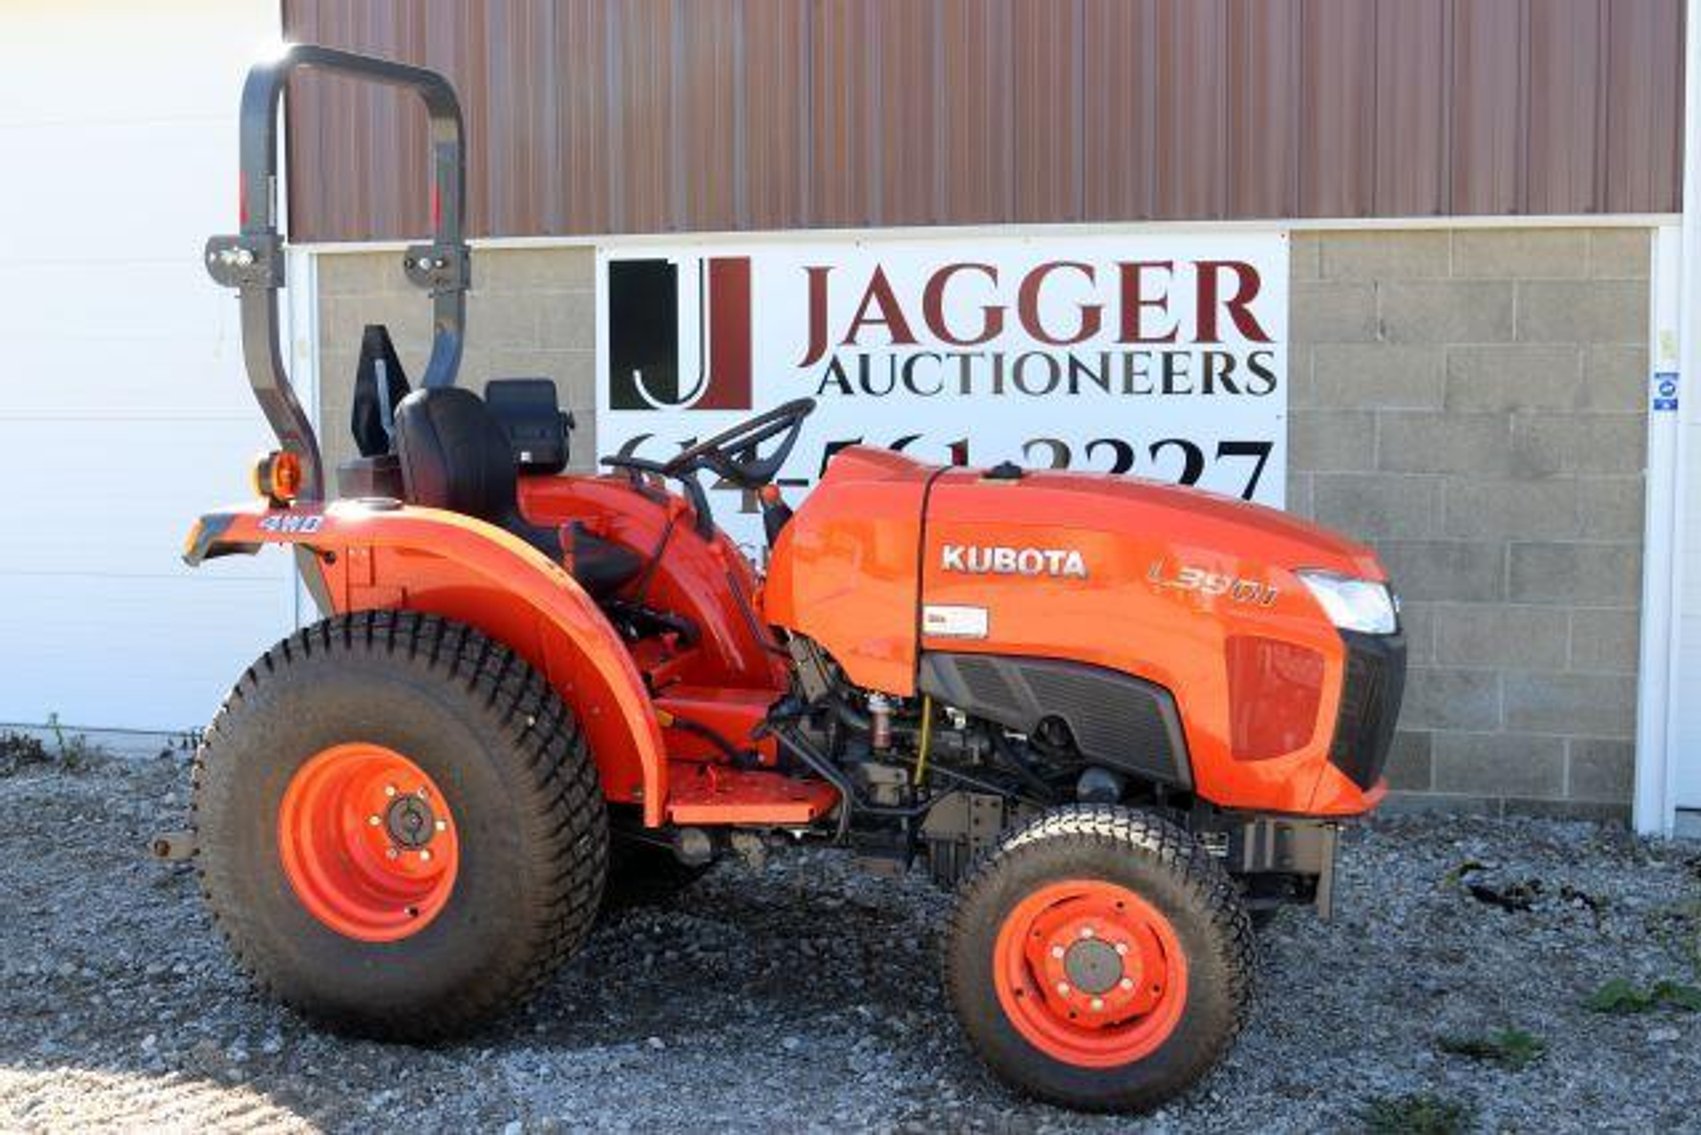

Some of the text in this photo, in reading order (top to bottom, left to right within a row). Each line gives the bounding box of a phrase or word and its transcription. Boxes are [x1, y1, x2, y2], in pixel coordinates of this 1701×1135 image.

[798, 258, 1277, 369] JAGGER
[816, 351, 1277, 397] AUCTIONEERS
[941, 544, 1088, 580] KUBOTA
